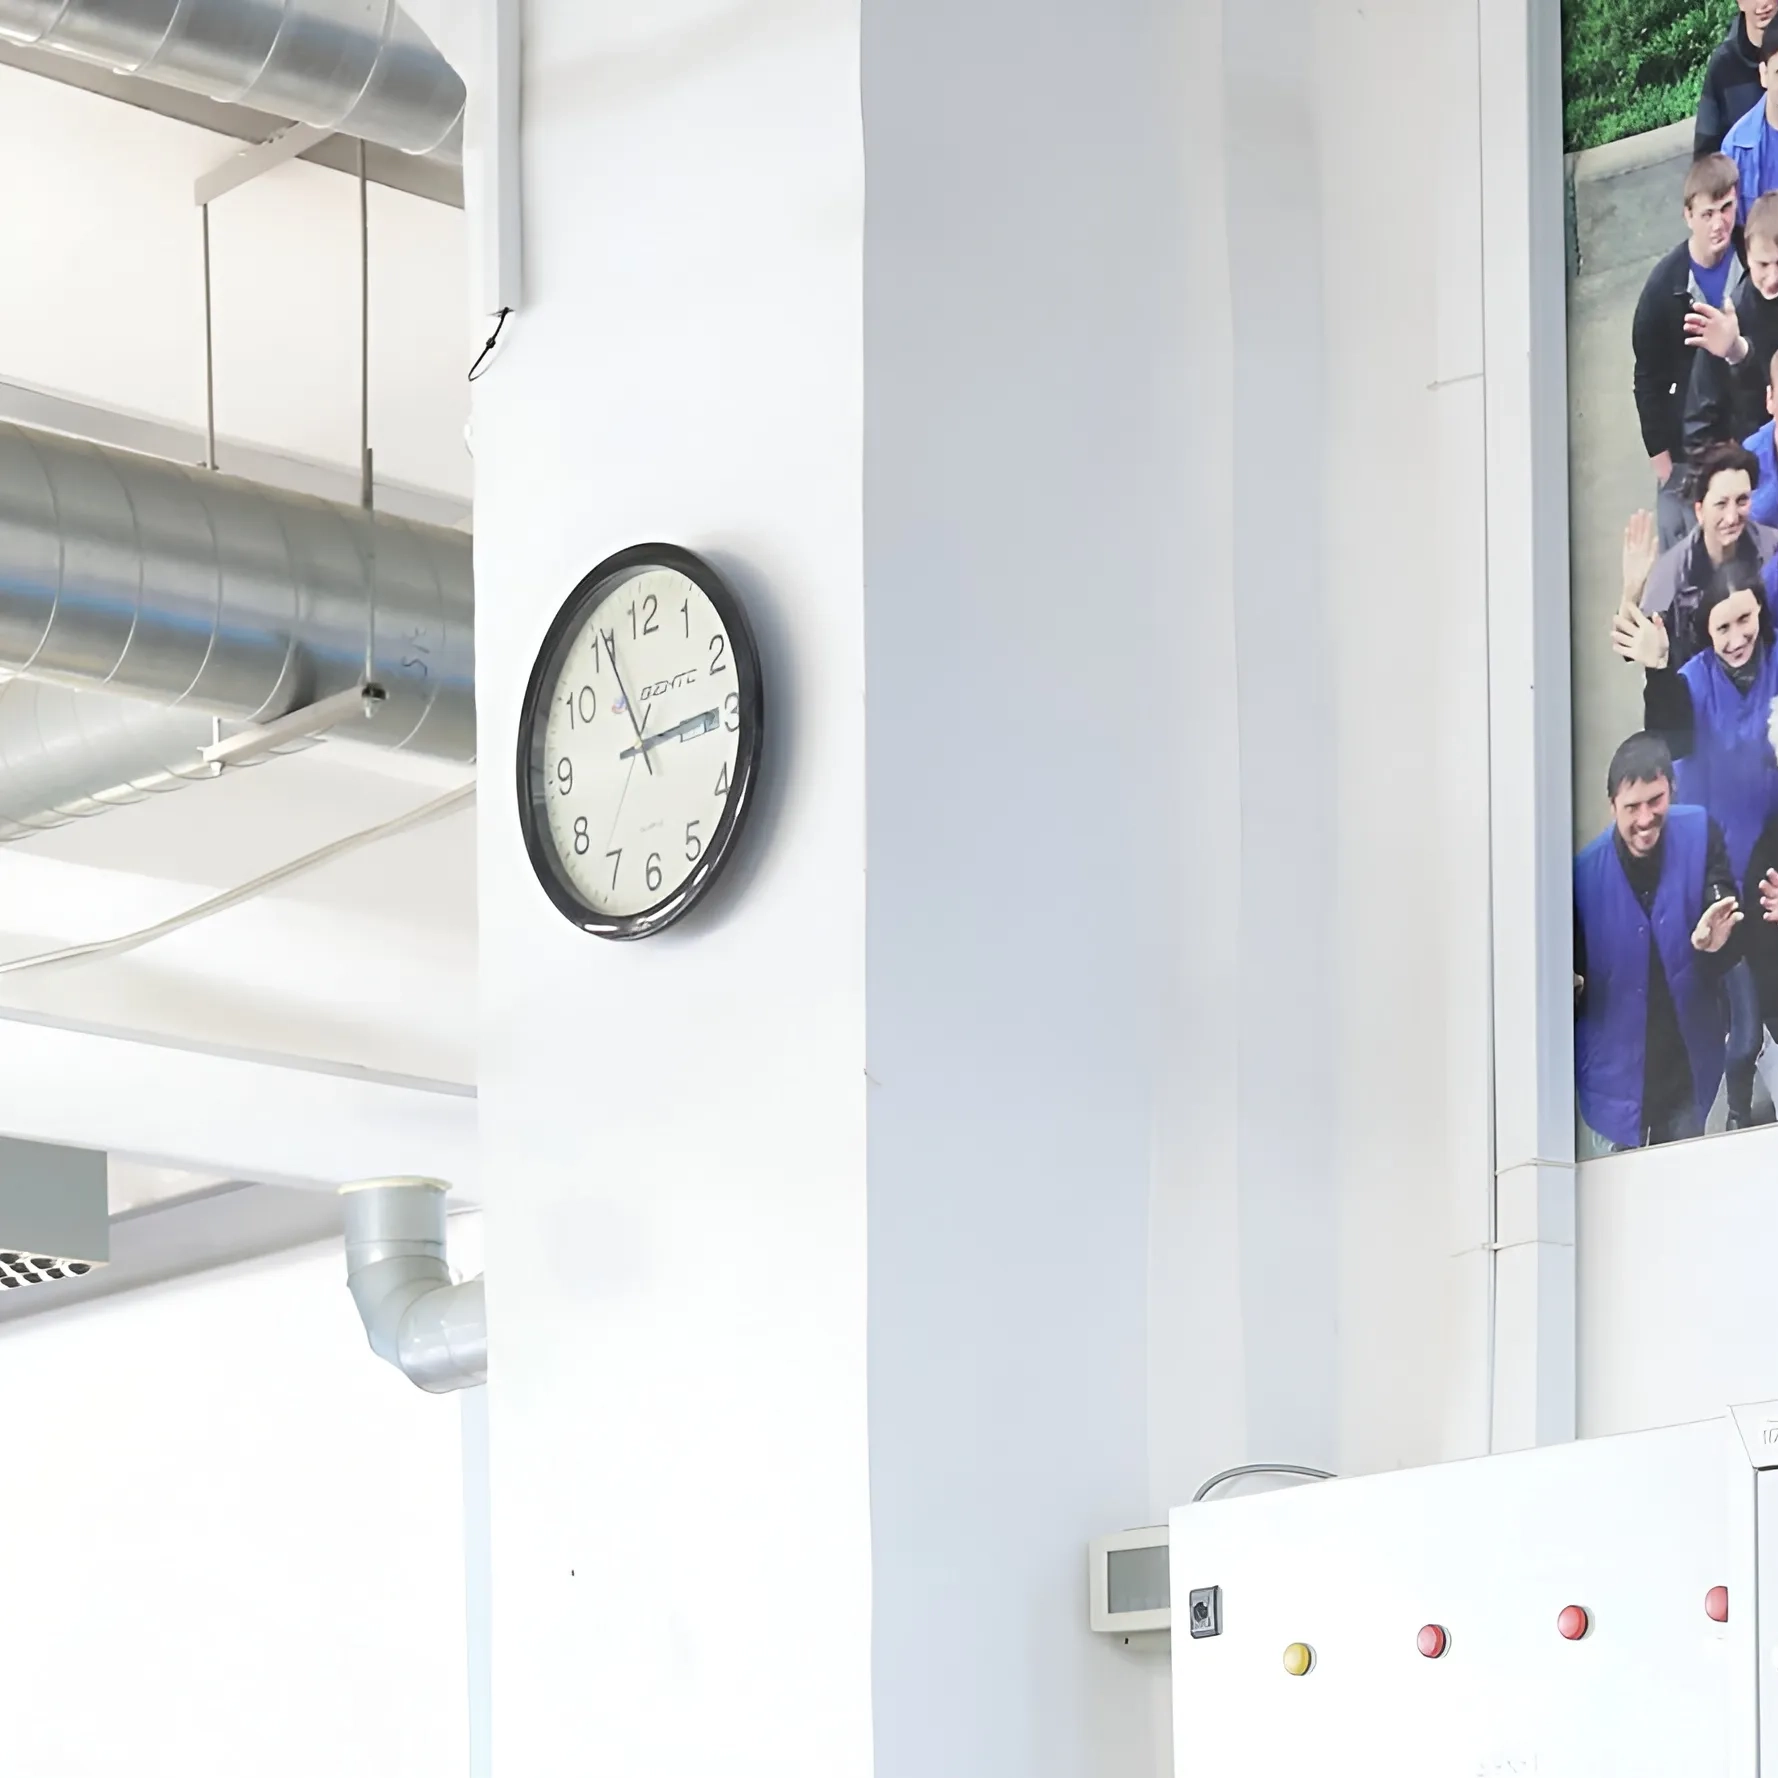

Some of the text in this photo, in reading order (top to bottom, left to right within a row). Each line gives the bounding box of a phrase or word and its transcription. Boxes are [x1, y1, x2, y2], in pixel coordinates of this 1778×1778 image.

[628, 594, 660, 639] 12
[680, 597, 690, 638] 1
[709, 634, 726, 675] 2
[567, 685, 596, 730] 10
[724, 692, 740, 732] 3
[557, 757, 573, 795] 9
[714, 761, 731, 797] 4
[574, 816, 589, 854] 8
[685, 820, 701, 861] 5
[606, 848, 622, 890] 7
[646, 852, 662, 891] 6
